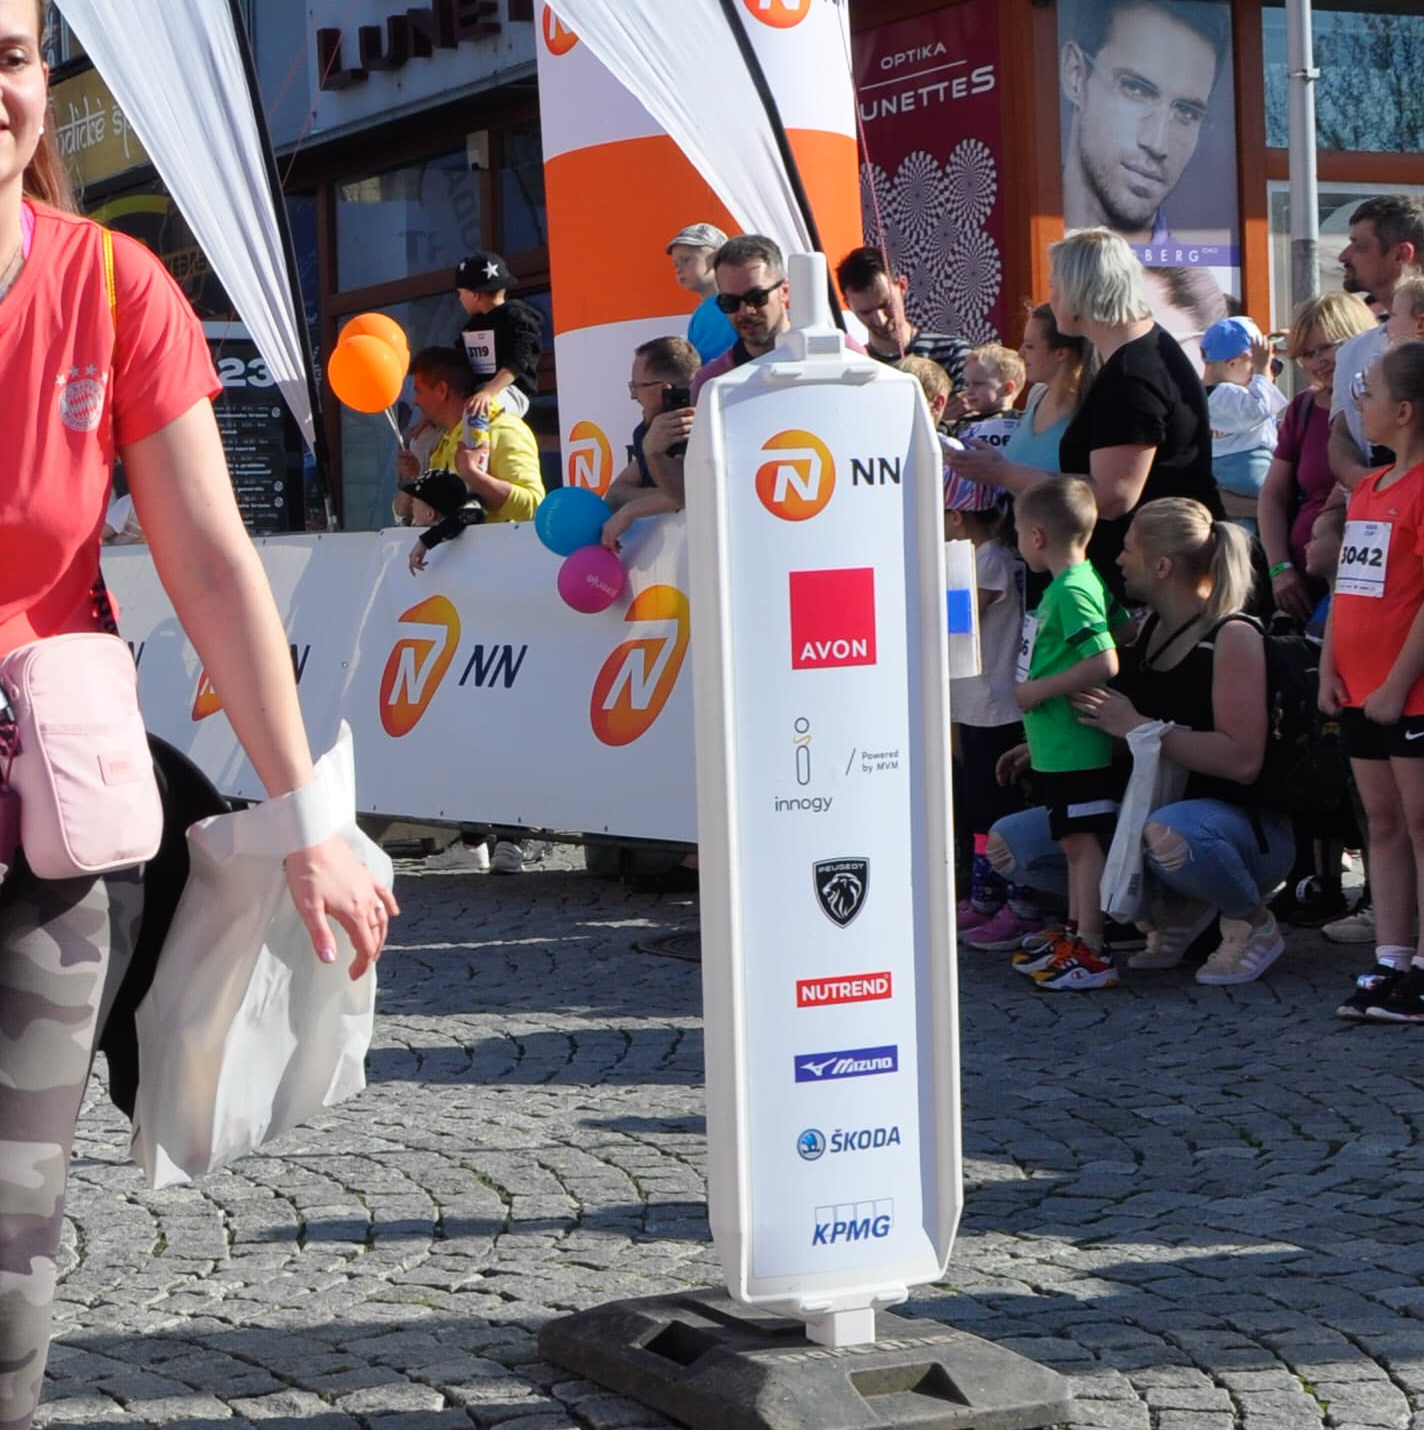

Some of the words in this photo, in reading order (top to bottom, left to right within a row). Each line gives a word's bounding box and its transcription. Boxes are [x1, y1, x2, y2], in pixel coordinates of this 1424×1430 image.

[880, 42, 947, 70] OPTIKA
[859, 64, 996, 122] UNETTES
[1143, 248, 1200, 263] BERG
[850, 456, 902, 487] NN
[799, 637, 868, 661] AVON
[458, 643, 529, 689] NN
[861, 749, 900, 760] Powered
[861, 762, 873, 773] by
[876, 760, 899, 771] MVM
[774, 794, 833, 814] innogy
[817, 861, 866, 873] PEUGEOT
[801, 977, 888, 1001] NUTREND
[829, 1126, 901, 1154] ŠKODA
[810, 1215, 891, 1247] KPMG
